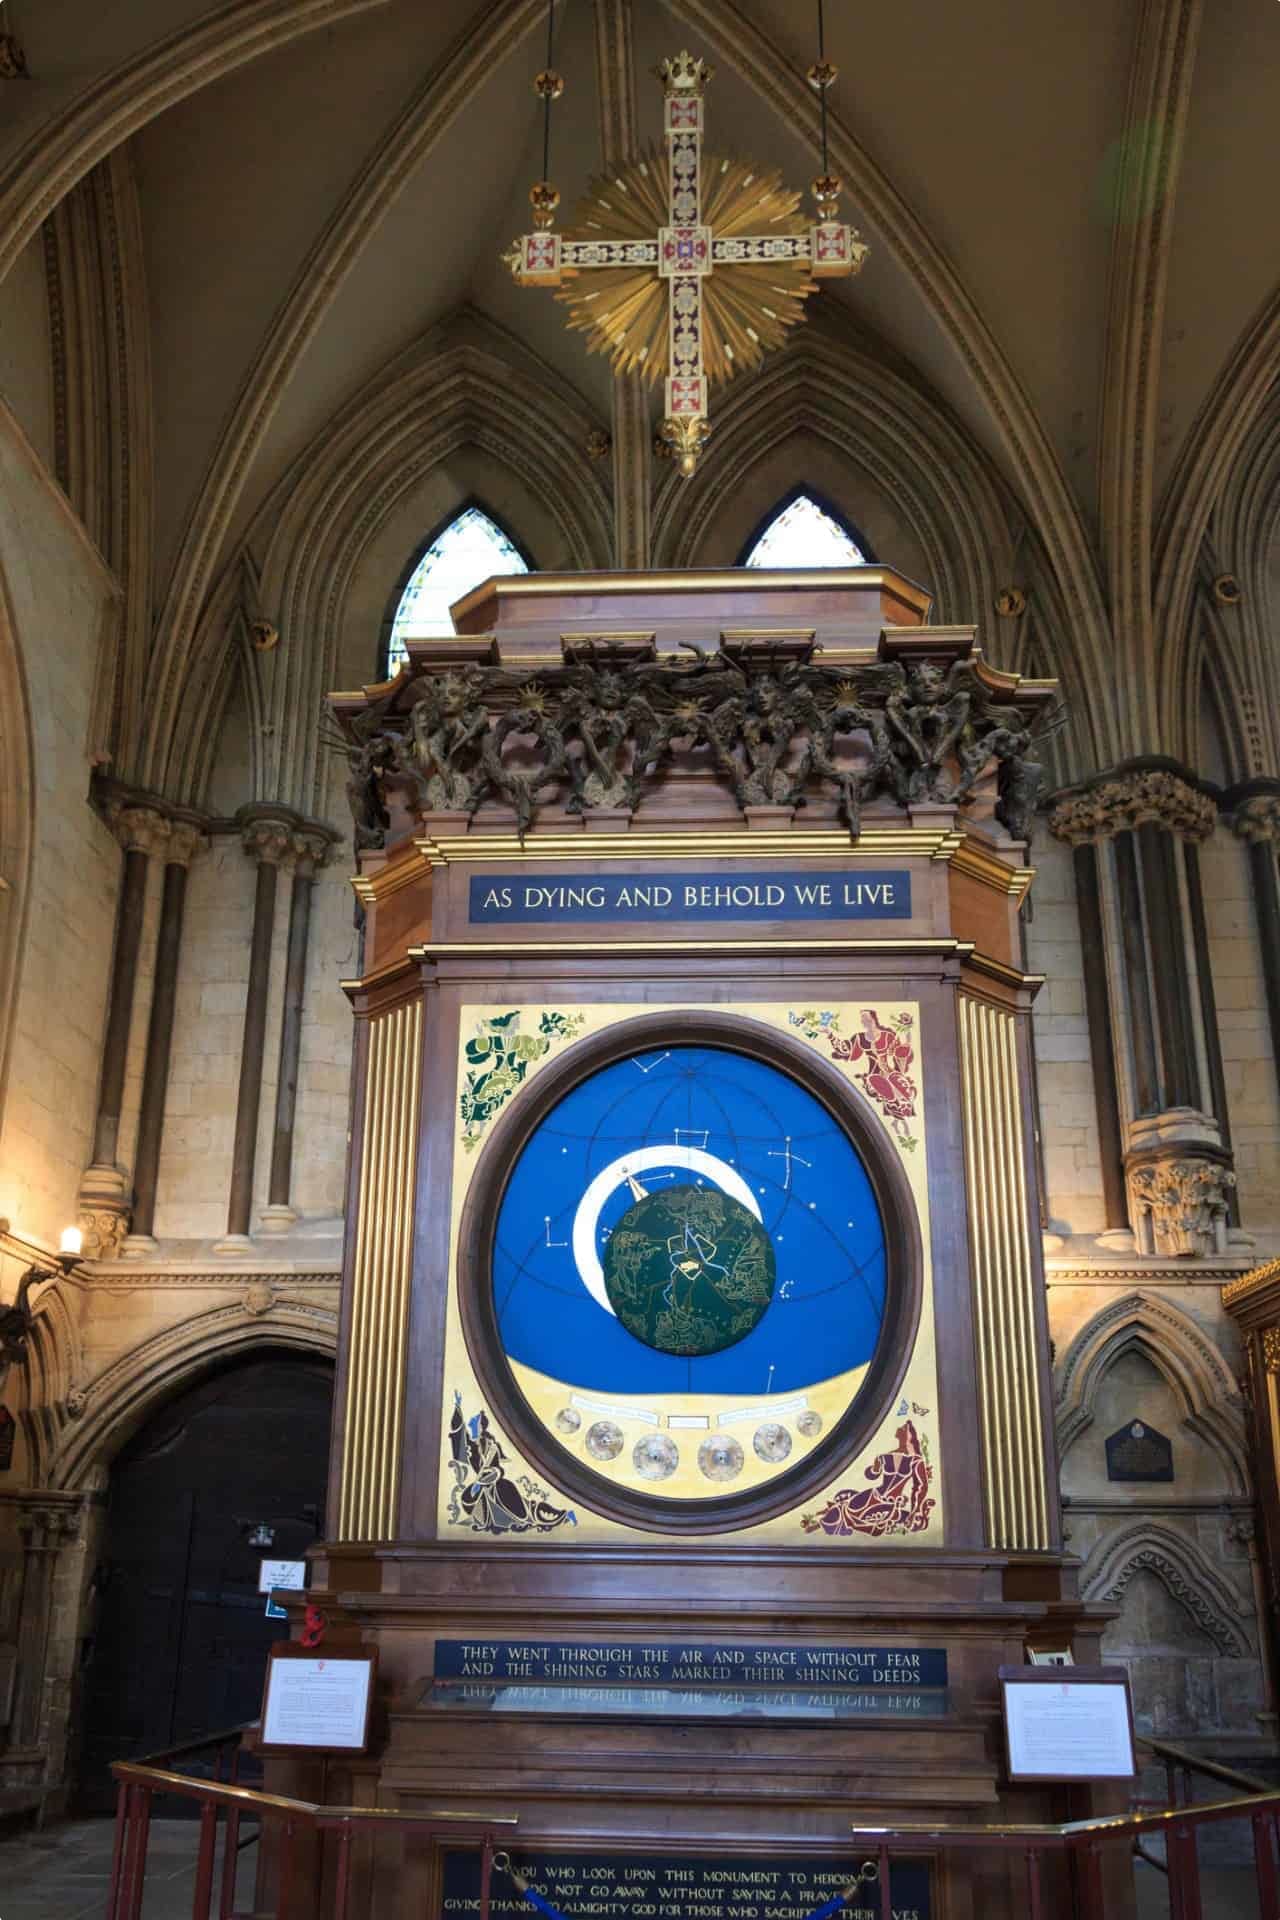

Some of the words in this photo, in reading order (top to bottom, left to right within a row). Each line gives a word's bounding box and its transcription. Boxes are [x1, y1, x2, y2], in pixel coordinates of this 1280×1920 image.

[483, 888, 512, 908] AS
[524, 887, 605, 908] DYING
[615, 886, 672, 907] AND
[685, 885, 785, 907] BEHOLD
[794, 884, 832, 906] WE
[844, 884, 896, 905] LIVE
[461, 1646, 498, 1660] THEY
[508, 1647, 548, 1661] WENT
[559, 1648, 632, 1662] THROUGH
[641, 1649, 669, 1663] THE
[679, 1650, 704, 1663] AIR
[713, 1651, 745, 1664] AND
[754, 1651, 797, 1665] SPACE
[807, 1652, 878, 1666] WITHOUT
[887, 1653, 920, 1667] FEAR
[461, 1663, 494, 1675] AND
[505, 1663, 532, 1676] THE
[544, 1664, 607, 1677] SHINING
[618, 1665, 660, 1678] STARS
[672, 1666, 731, 1680] MARKED
[742, 1667, 785, 1681] THEIR
[796, 1668, 860, 1682] SHINING
[872, 1669, 920, 1683] DEEDS
[545, 1867, 575, 1879] WHO
[582, 1868, 616, 1880] LOOK
[624, 1869, 656, 1880] UPON
[664, 1870, 695, 1881] THIS
[703, 1871, 781, 1883] MONUMENT
[788, 1872, 805, 1883] TO
[555, 1884, 583, 1896] NOT
[590, 1886, 609, 1897] GO
[613, 1886, 648, 1898] AWAY
[658, 1887, 724, 1899] WITHOUT
[732, 1889, 776, 1901] SAYING
[780, 1889, 792, 1901] A
[563, 1902, 630, 1914] ALMIGHTY
[632, 1903, 656, 1914] GOD
[659, 1904, 681, 1915] FOR
[685, 1905, 723, 1917] THOSE
[727, 1906, 758, 1918] WHO
